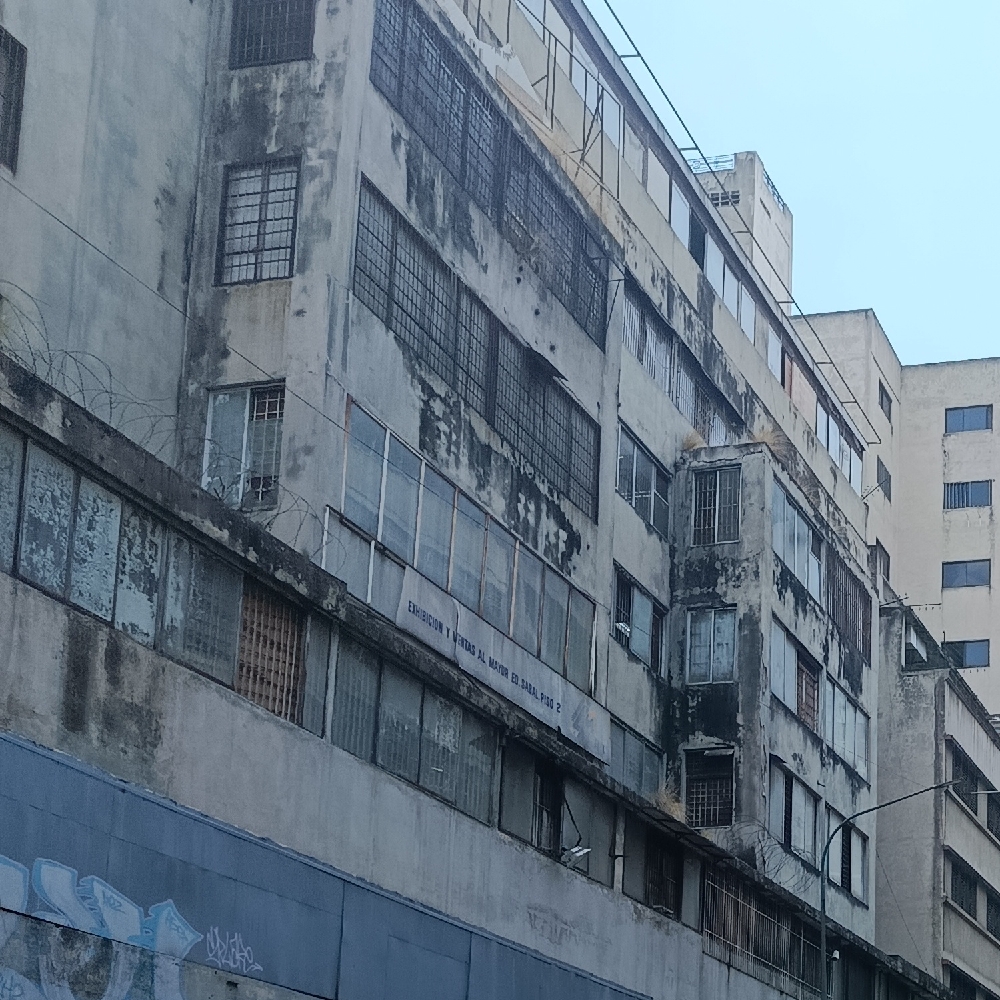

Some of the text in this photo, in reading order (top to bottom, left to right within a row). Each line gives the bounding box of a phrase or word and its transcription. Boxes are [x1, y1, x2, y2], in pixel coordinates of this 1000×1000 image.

[408, 600, 444, 634] EXHIBICION
[446, 627, 451, 639] Y
[478, 649, 486, 664] AL
[488, 656, 509, 680] MAYOR
[556, 702, 562, 713] 2
